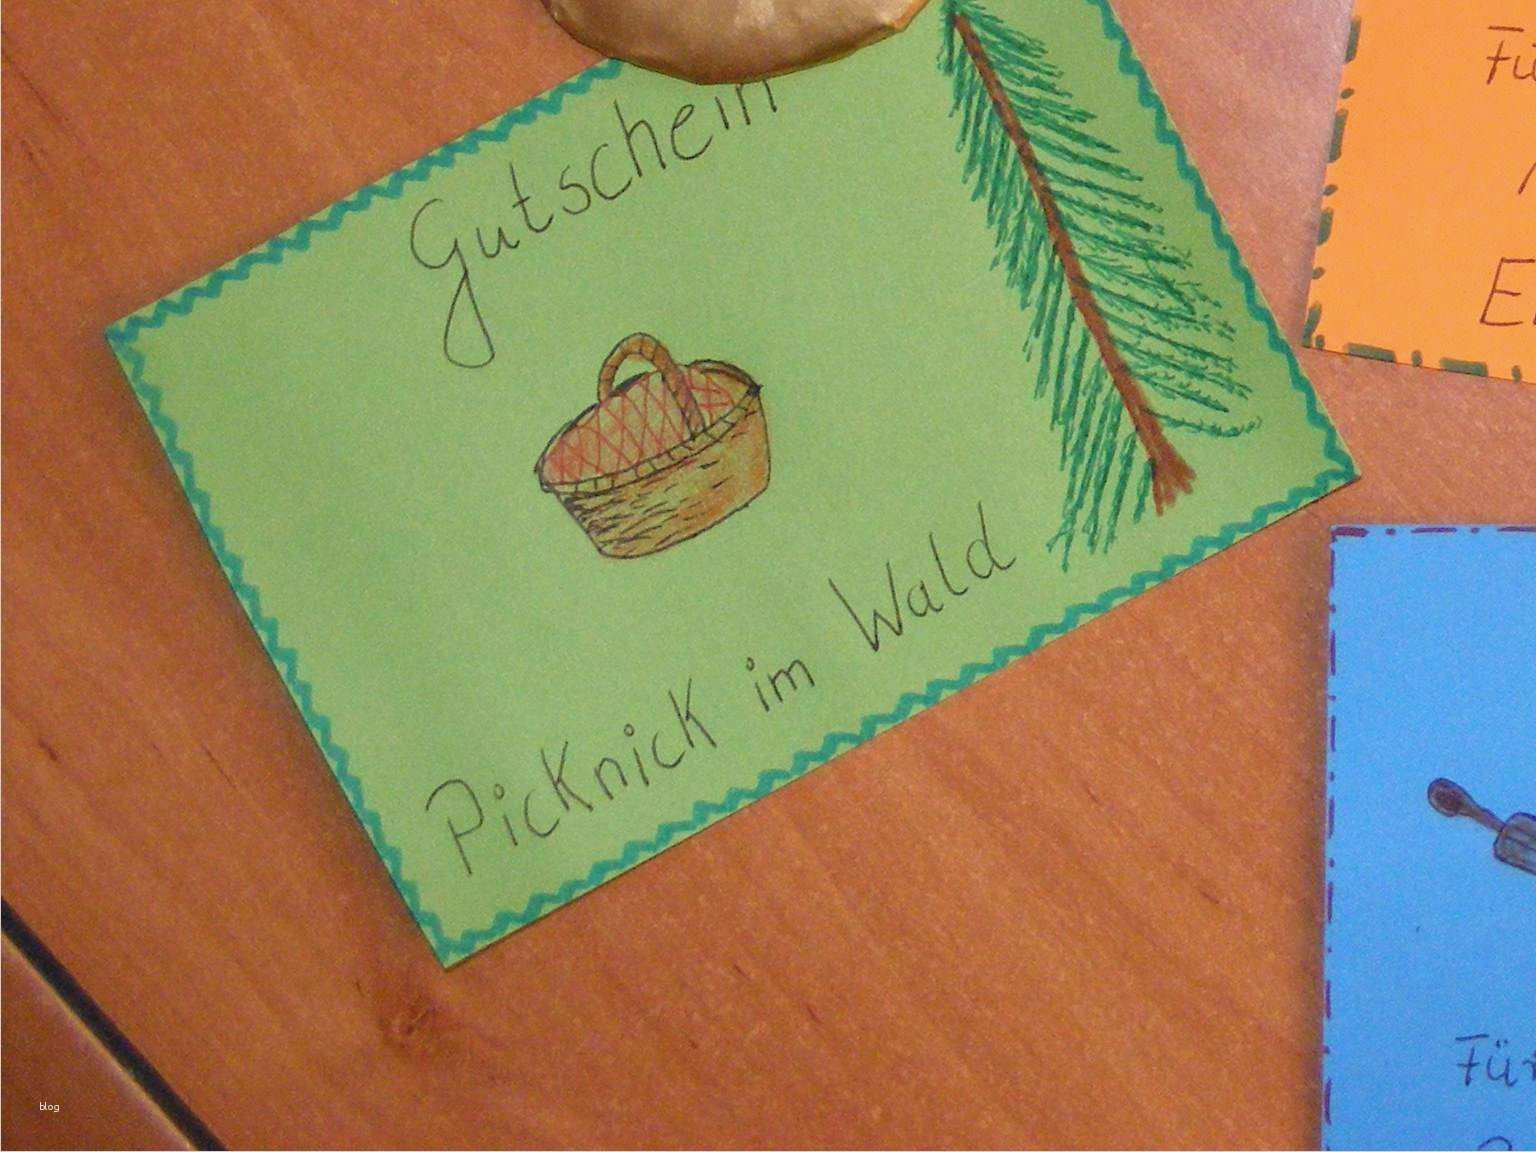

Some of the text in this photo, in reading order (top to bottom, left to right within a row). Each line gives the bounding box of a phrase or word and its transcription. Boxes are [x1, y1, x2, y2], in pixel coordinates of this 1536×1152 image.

[408, 77, 780, 369] Gutschein
[744, 655, 817, 714] im
[826, 501, 1018, 654] Wald
